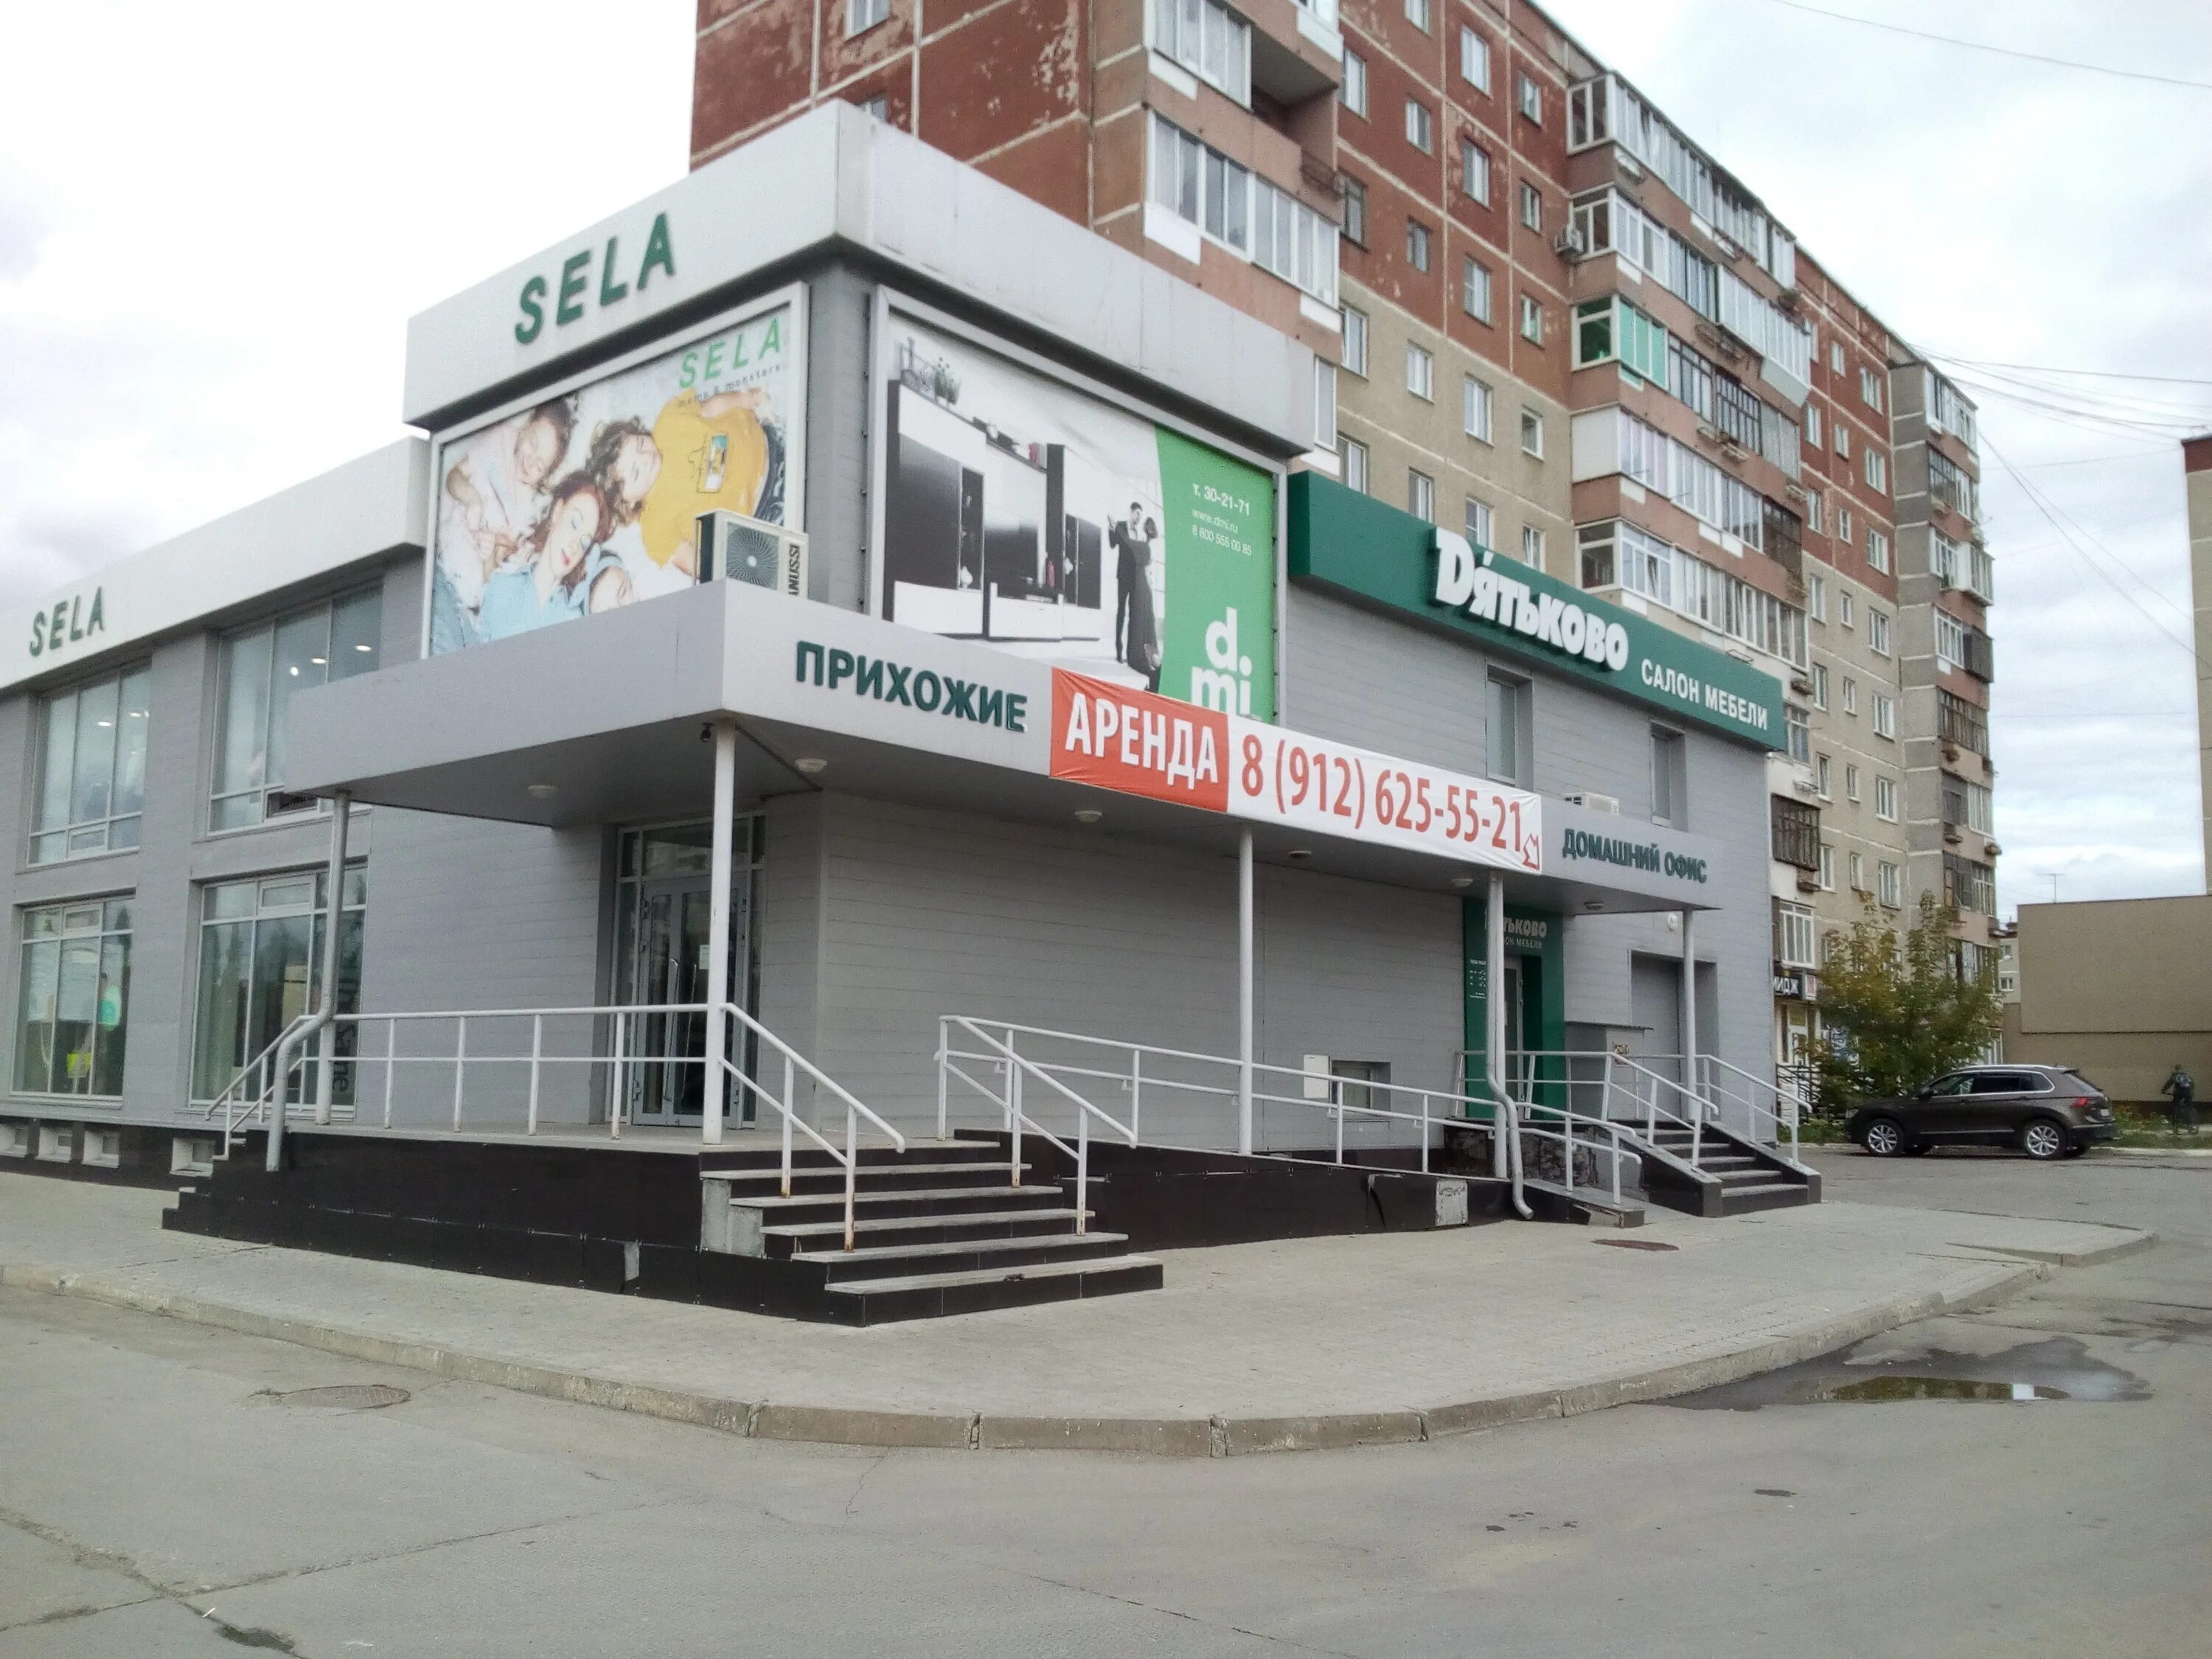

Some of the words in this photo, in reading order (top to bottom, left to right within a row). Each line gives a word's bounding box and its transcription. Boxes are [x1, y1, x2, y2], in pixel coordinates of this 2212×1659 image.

[514, 212, 675, 345] SELA
[679, 317, 780, 389] SELA
[1204, 485, 1250, 517] 30-21-71
[1192, 524, 1198, 537] 8
[1231, 539, 1242, 552] 00
[29, 585, 105, 658] SELA
[796, 639, 1029, 734] ПРИХОЖИЕ
[1641, 658, 1700, 704] САЛОН
[1705, 684, 1768, 731] МЕБЕЛИ
[1065, 692, 1219, 790] АРЕНДА
[1241, 733, 1264, 798] 8
[1274, 739, 1366, 830] (912)
[1375, 768, 1523, 852] 625-55-21
[1562, 827, 1660, 873] ДОМАШНИЙ
[1663, 851, 1708, 884] ОФИС
